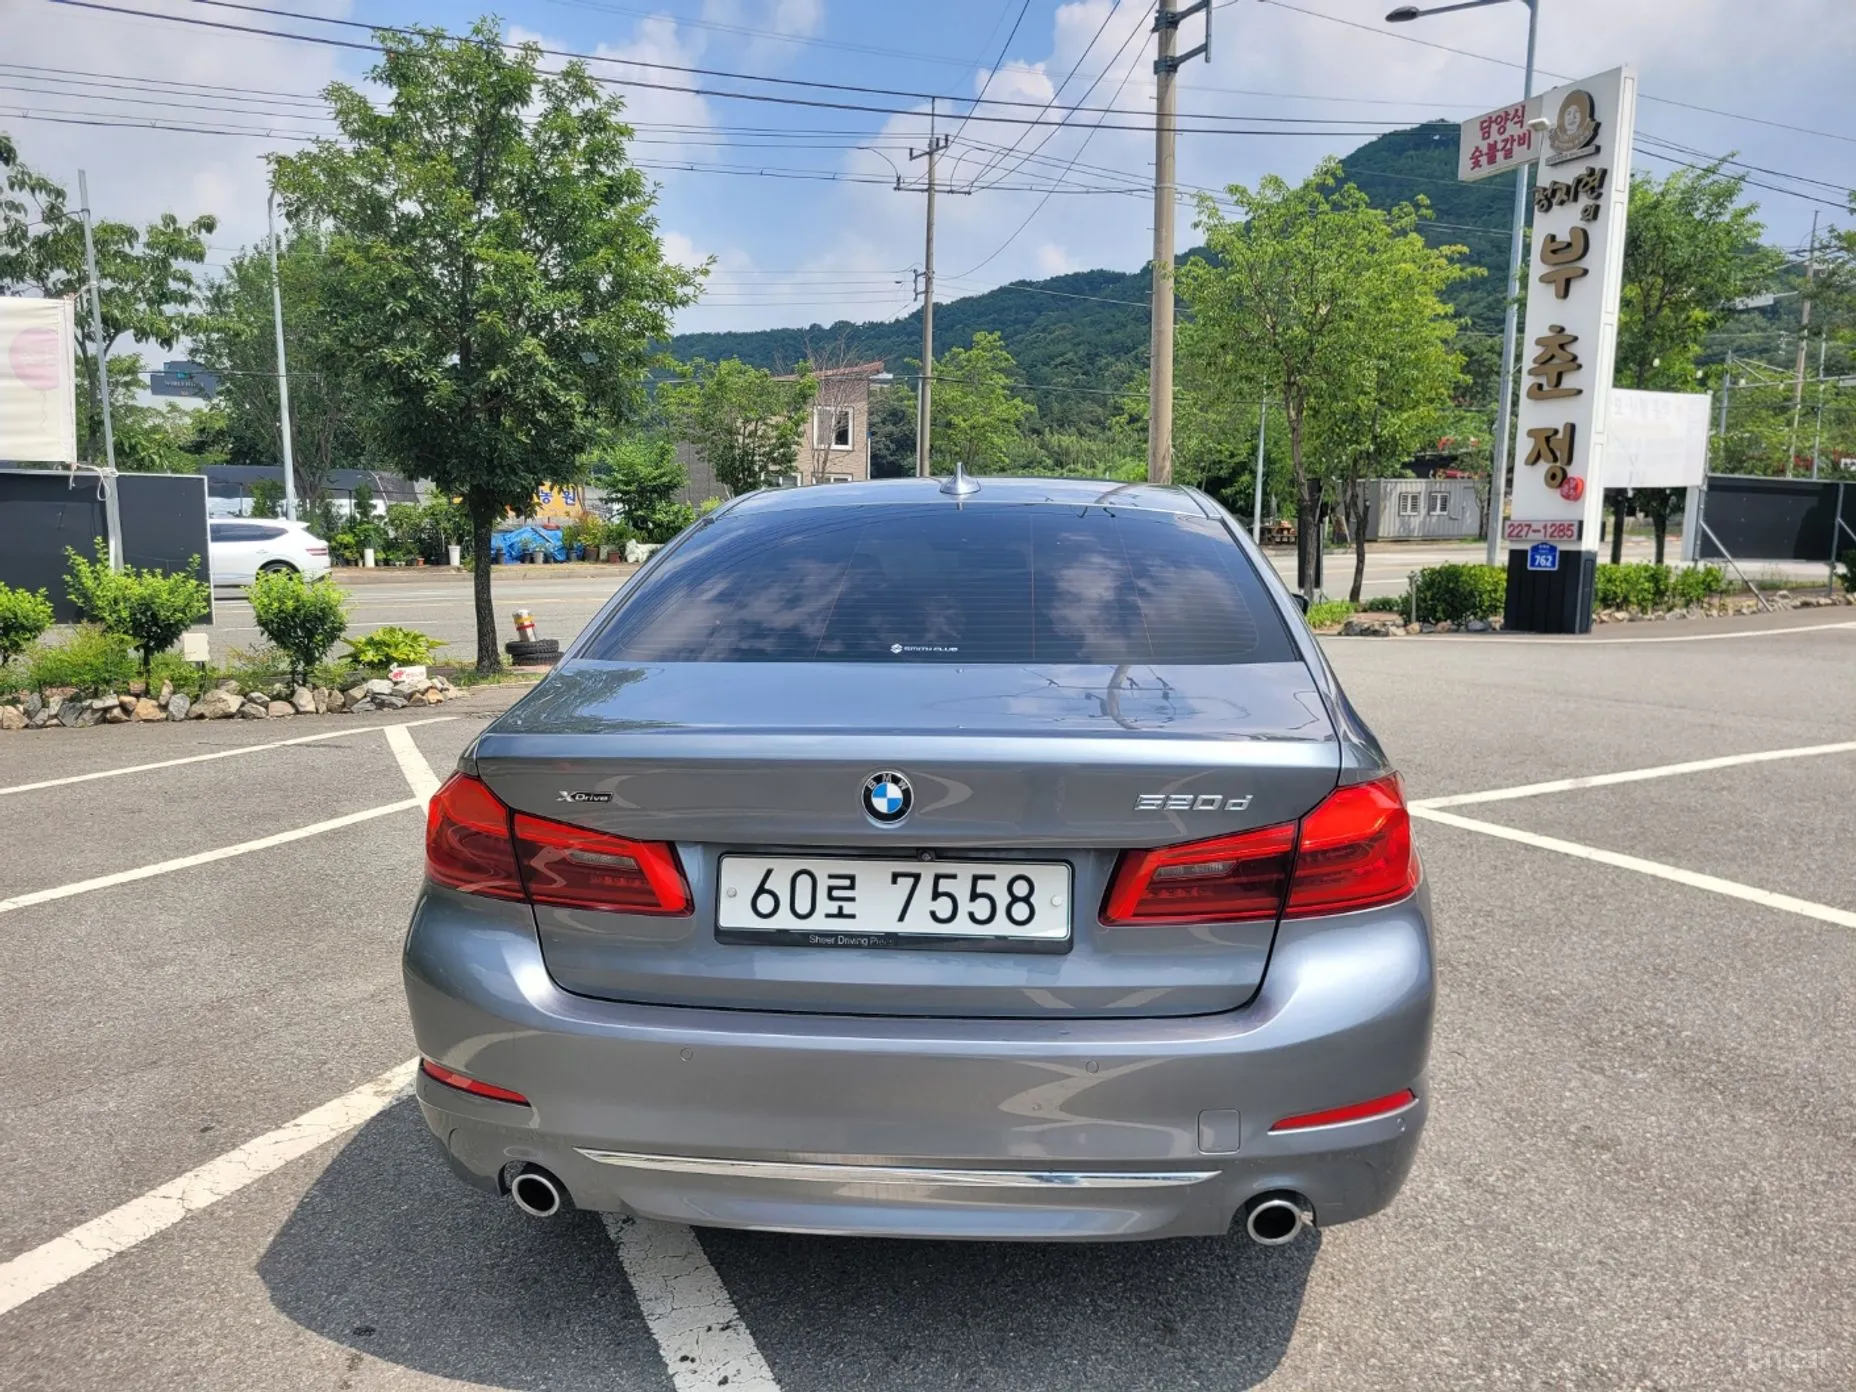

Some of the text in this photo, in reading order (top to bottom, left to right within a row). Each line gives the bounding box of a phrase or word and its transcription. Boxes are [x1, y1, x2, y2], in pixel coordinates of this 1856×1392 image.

[1479, 104, 1526, 141] 담양식
[1469, 129, 1532, 170] 숯불갈비
[1507, 523, 1575, 539] 227-1285
[1534, 555, 1553, 567] 762
[865, 773, 910, 790] BMW
[750, 867, 1036, 926] 60로 7558
[809, 934, 836, 945] Sheer
[837, 935, 869, 946] Driving
